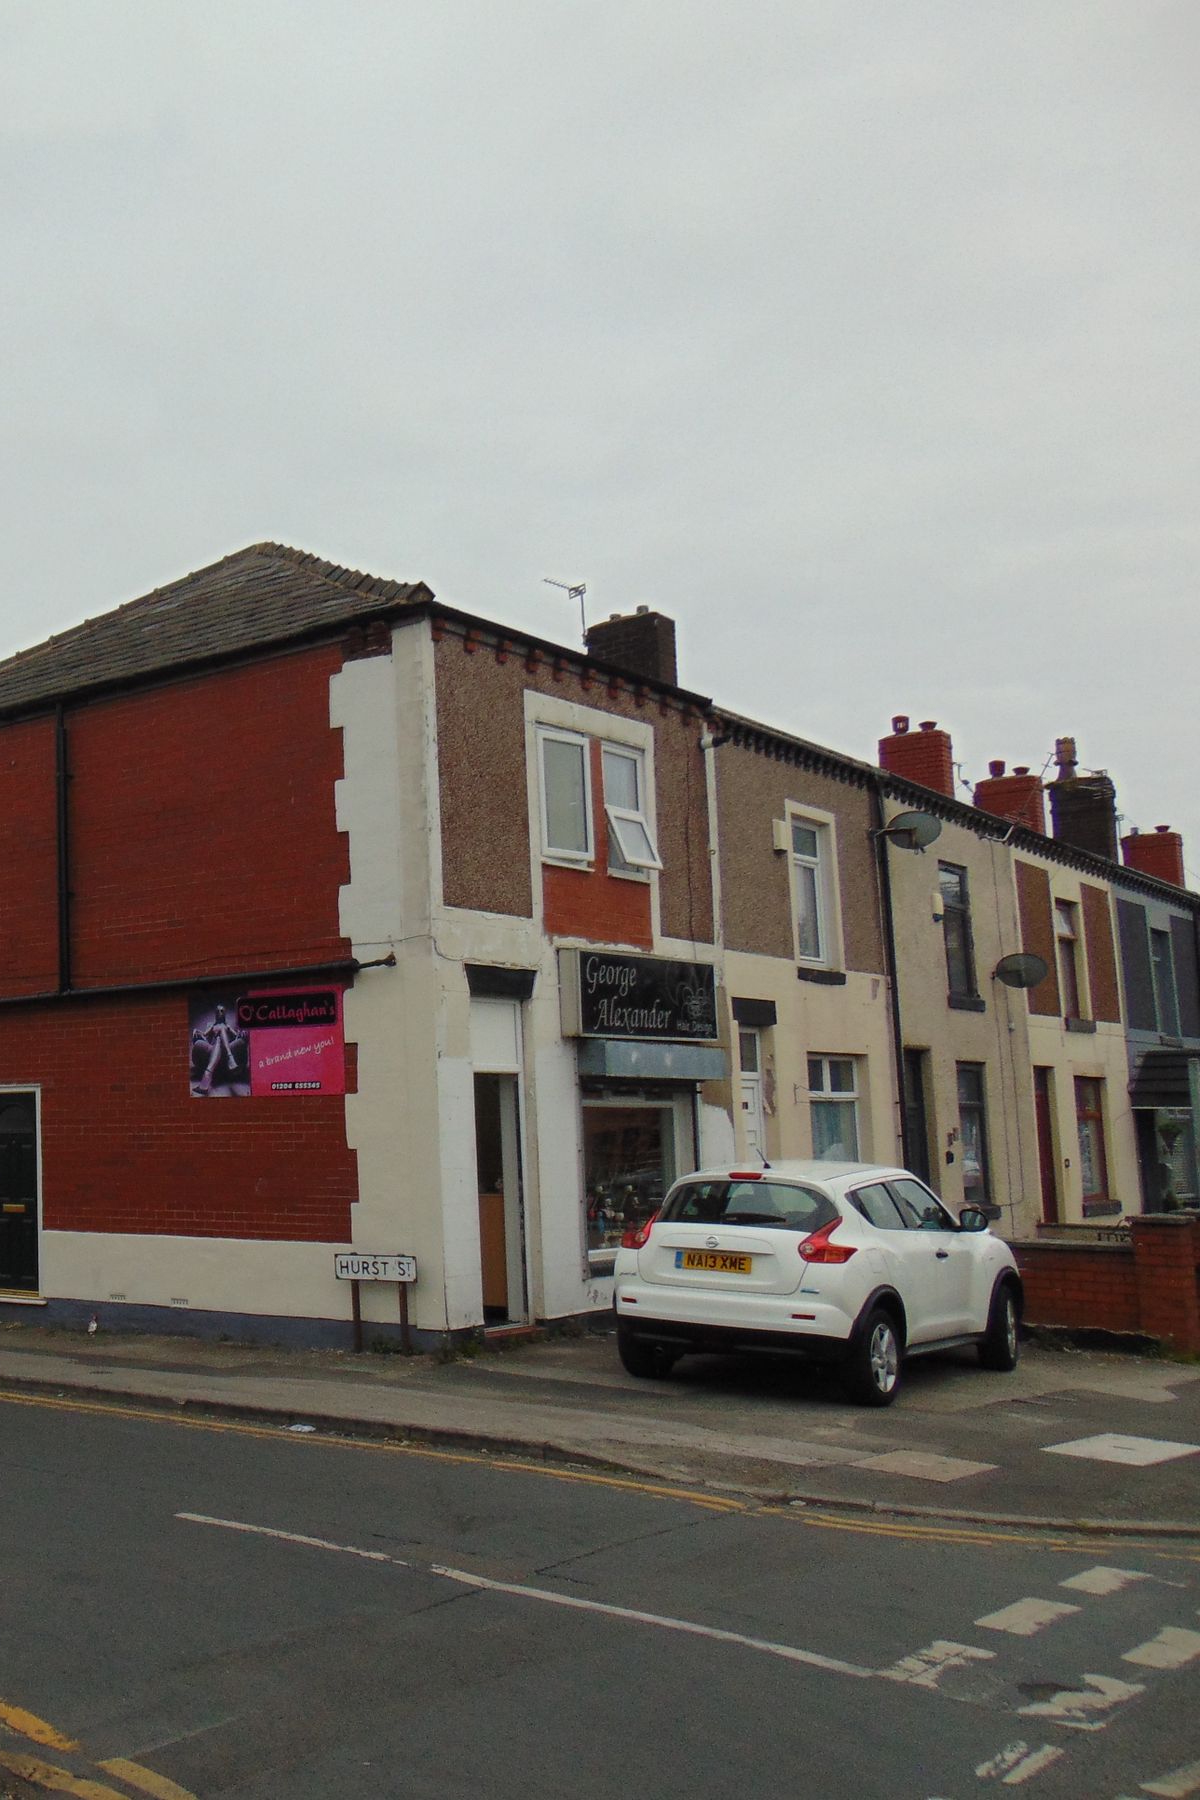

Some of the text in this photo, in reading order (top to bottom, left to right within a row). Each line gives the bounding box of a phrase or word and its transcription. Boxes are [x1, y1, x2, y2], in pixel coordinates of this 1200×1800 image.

[586, 956, 637, 996] George
[239, 1000, 335, 1022] O'Callaghan's
[593, 996, 671, 1033] Alexander
[266, 1049, 293, 1066] brand
[293, 1044, 312, 1056] new
[340, 1260, 389, 1275] HURST
[686, 1252, 747, 1271] NA13 XME
